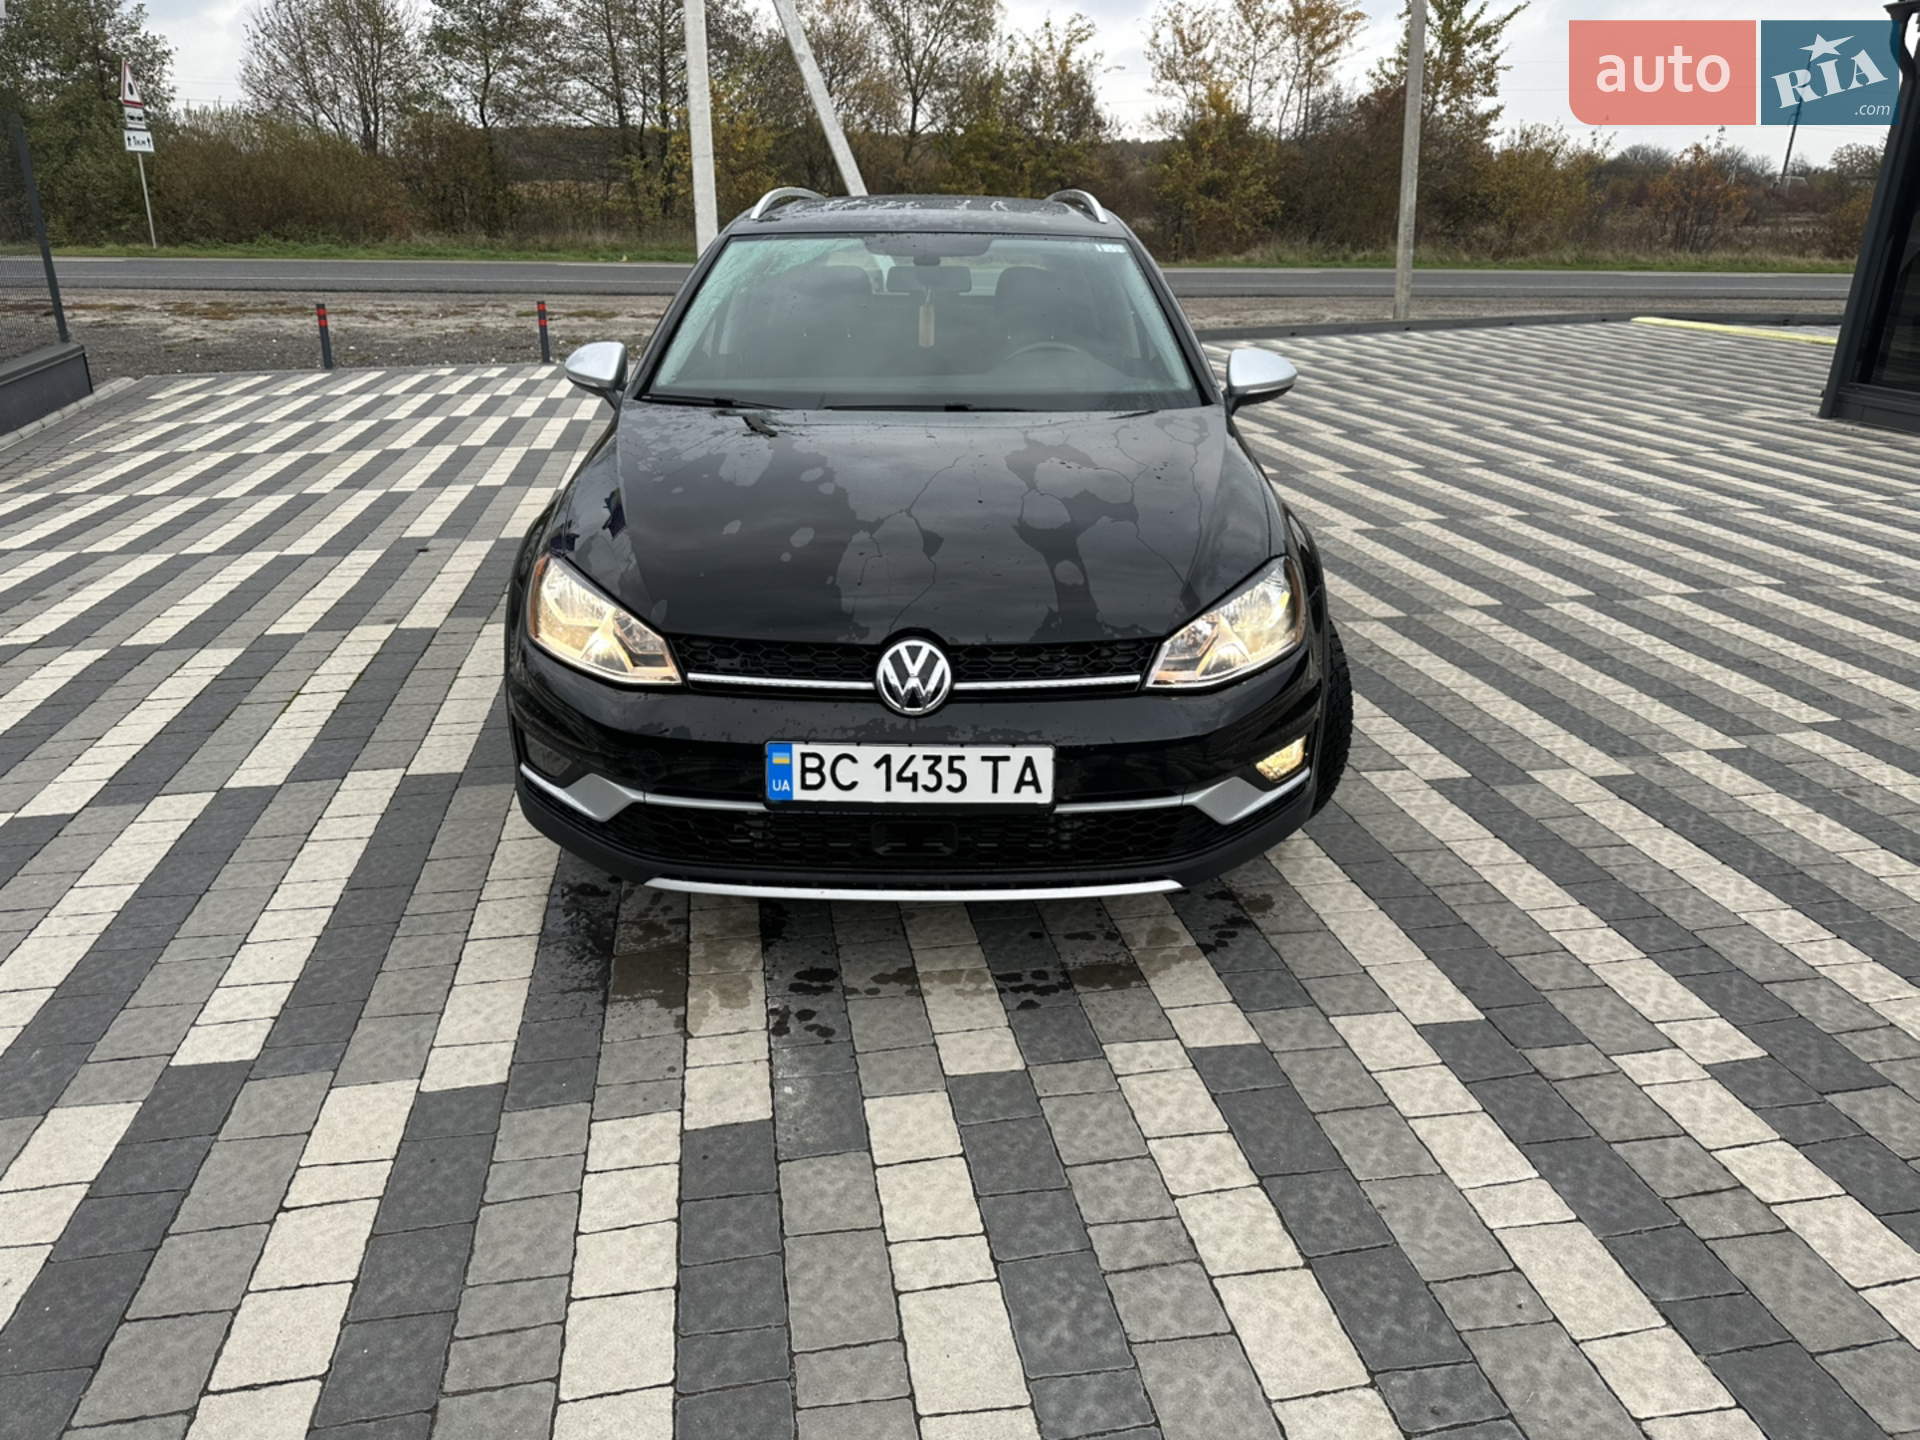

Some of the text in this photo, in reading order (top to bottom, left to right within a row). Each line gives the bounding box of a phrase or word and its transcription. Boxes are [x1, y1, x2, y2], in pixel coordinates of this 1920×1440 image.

[772, 779, 790, 792] UA
[800, 752, 1043, 794] BC 1435 TA
